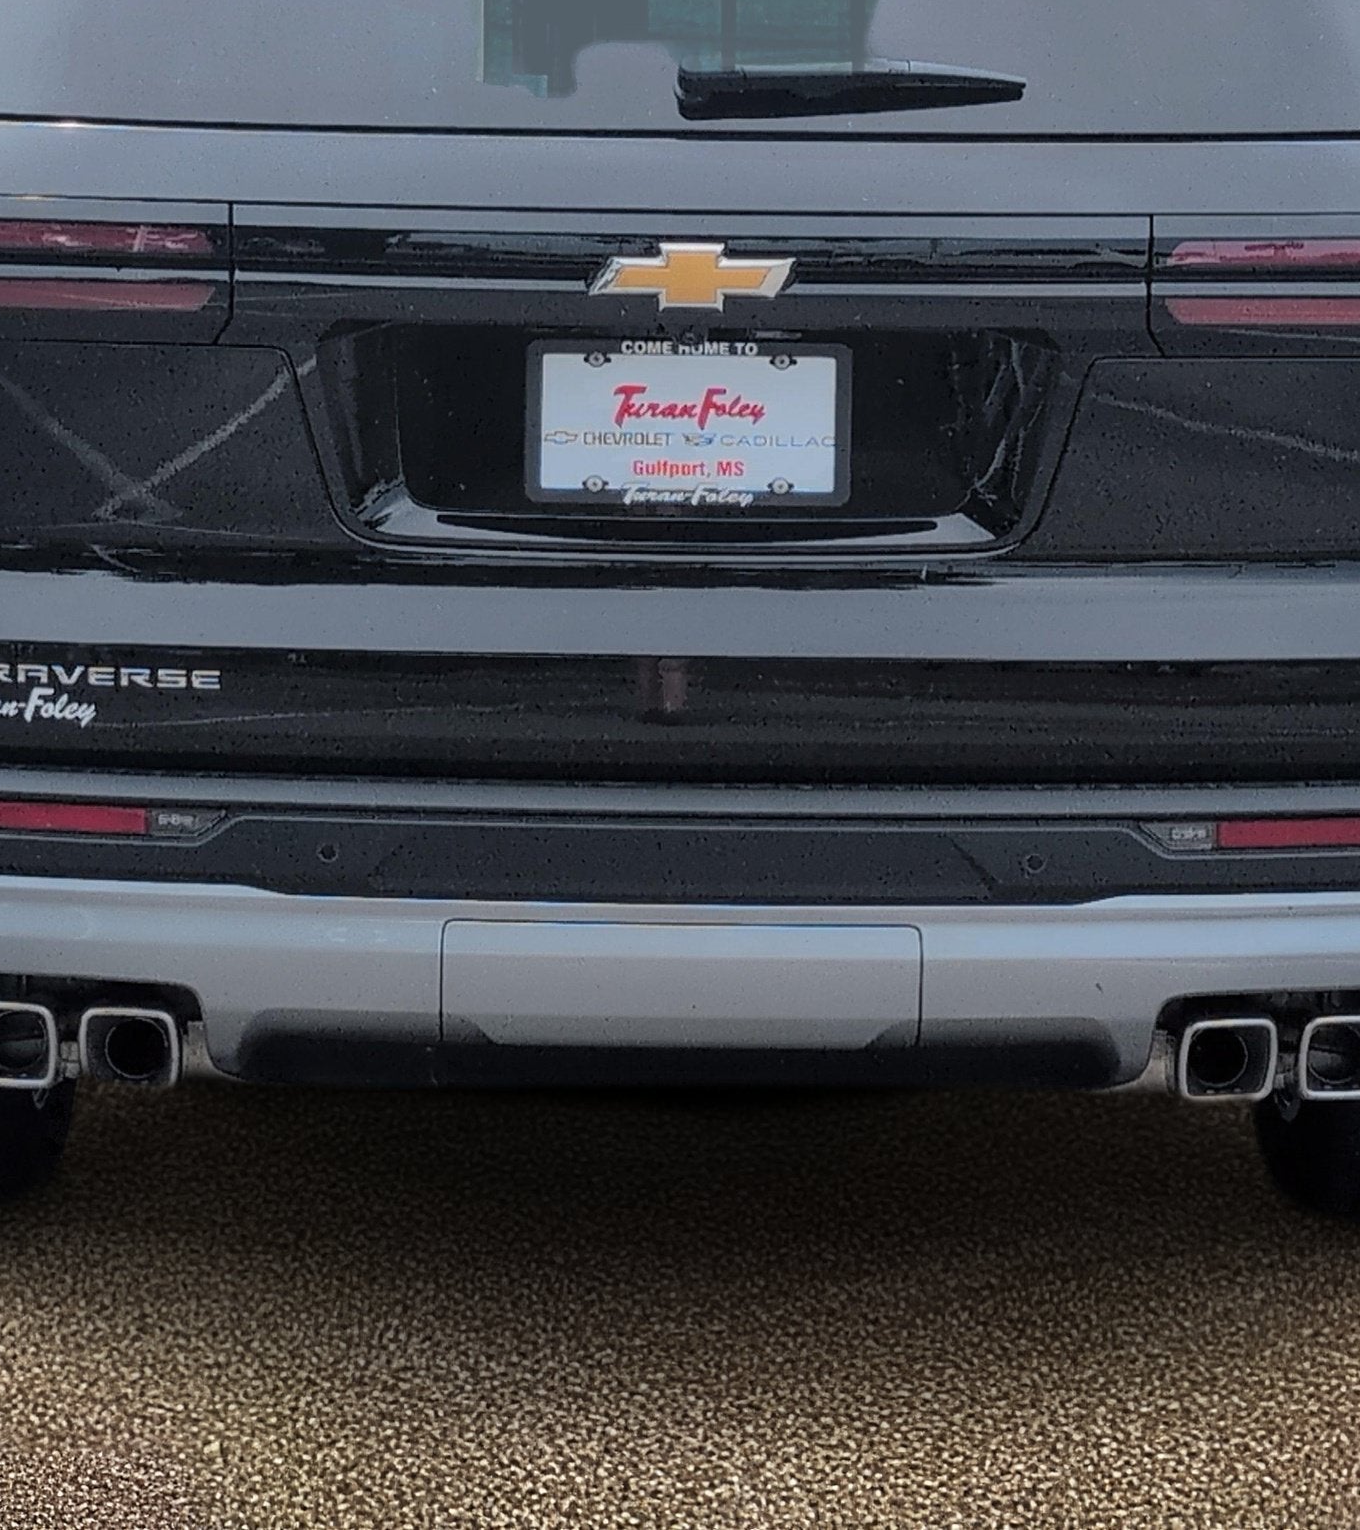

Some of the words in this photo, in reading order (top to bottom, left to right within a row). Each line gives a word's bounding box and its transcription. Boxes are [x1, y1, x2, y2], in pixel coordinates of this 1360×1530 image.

[620, 340, 673, 355] COME
[734, 342, 759, 356] TO
[613, 385, 698, 429] Turan
[697, 387, 766, 431] Foley
[583, 431, 672, 447] CHEVROLET
[720, 434, 836, 448] CADILLAC
[632, 460, 712, 479] Gulfport,
[716, 461, 745, 477] MS
